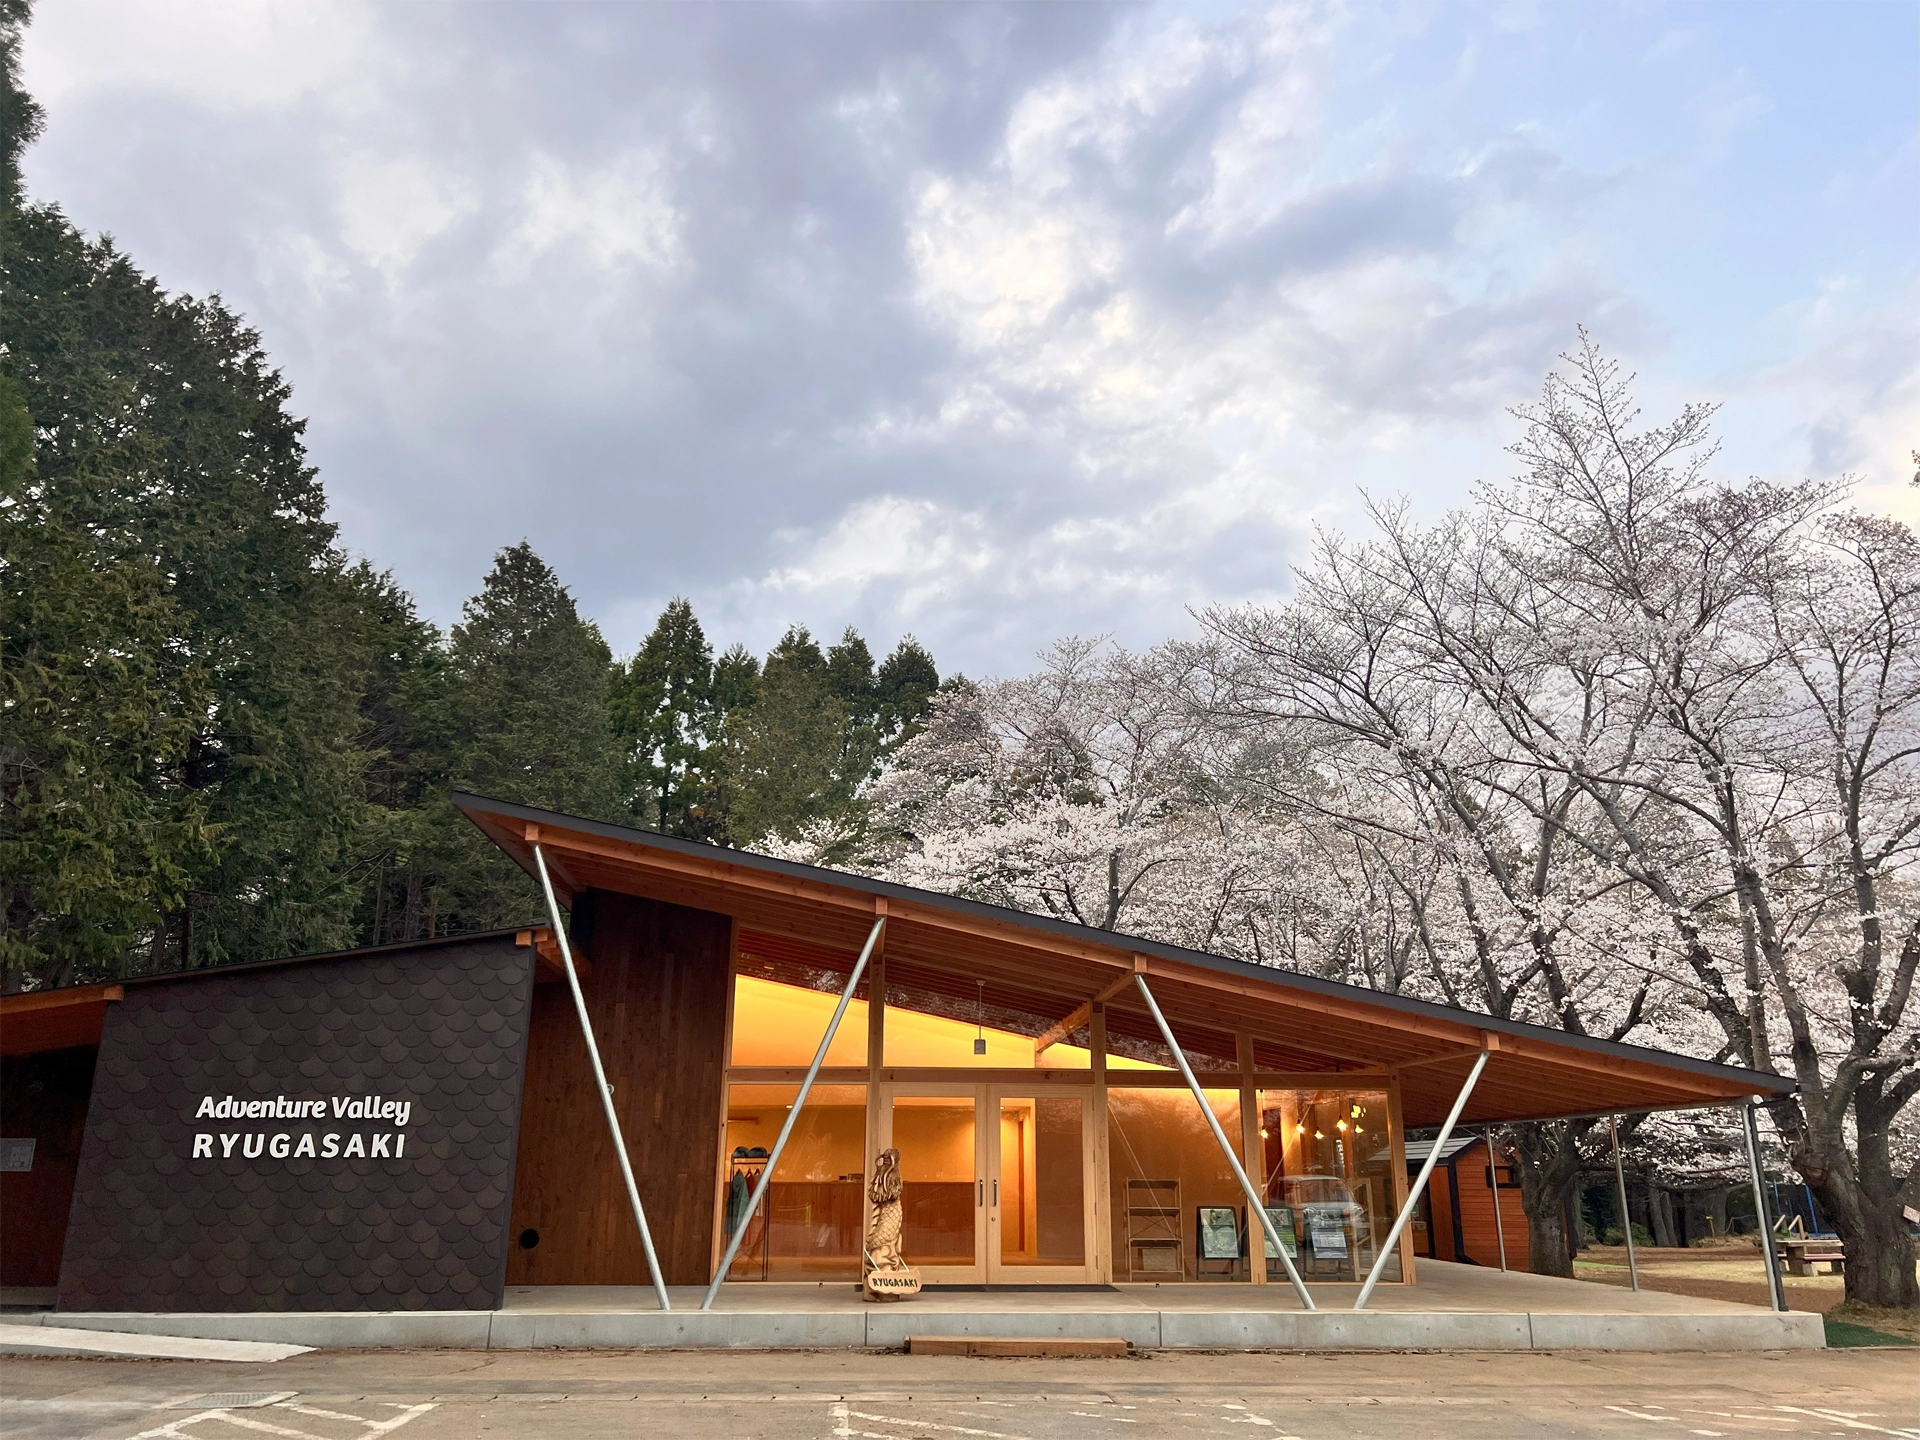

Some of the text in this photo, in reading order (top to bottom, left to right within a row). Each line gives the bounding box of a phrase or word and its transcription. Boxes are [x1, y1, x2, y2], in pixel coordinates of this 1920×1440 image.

[195, 1096, 411, 1126] Adventure Valley
[193, 1133, 405, 1158] RYUGASAKI
[872, 1278, 918, 1287] RYUGASAKI
